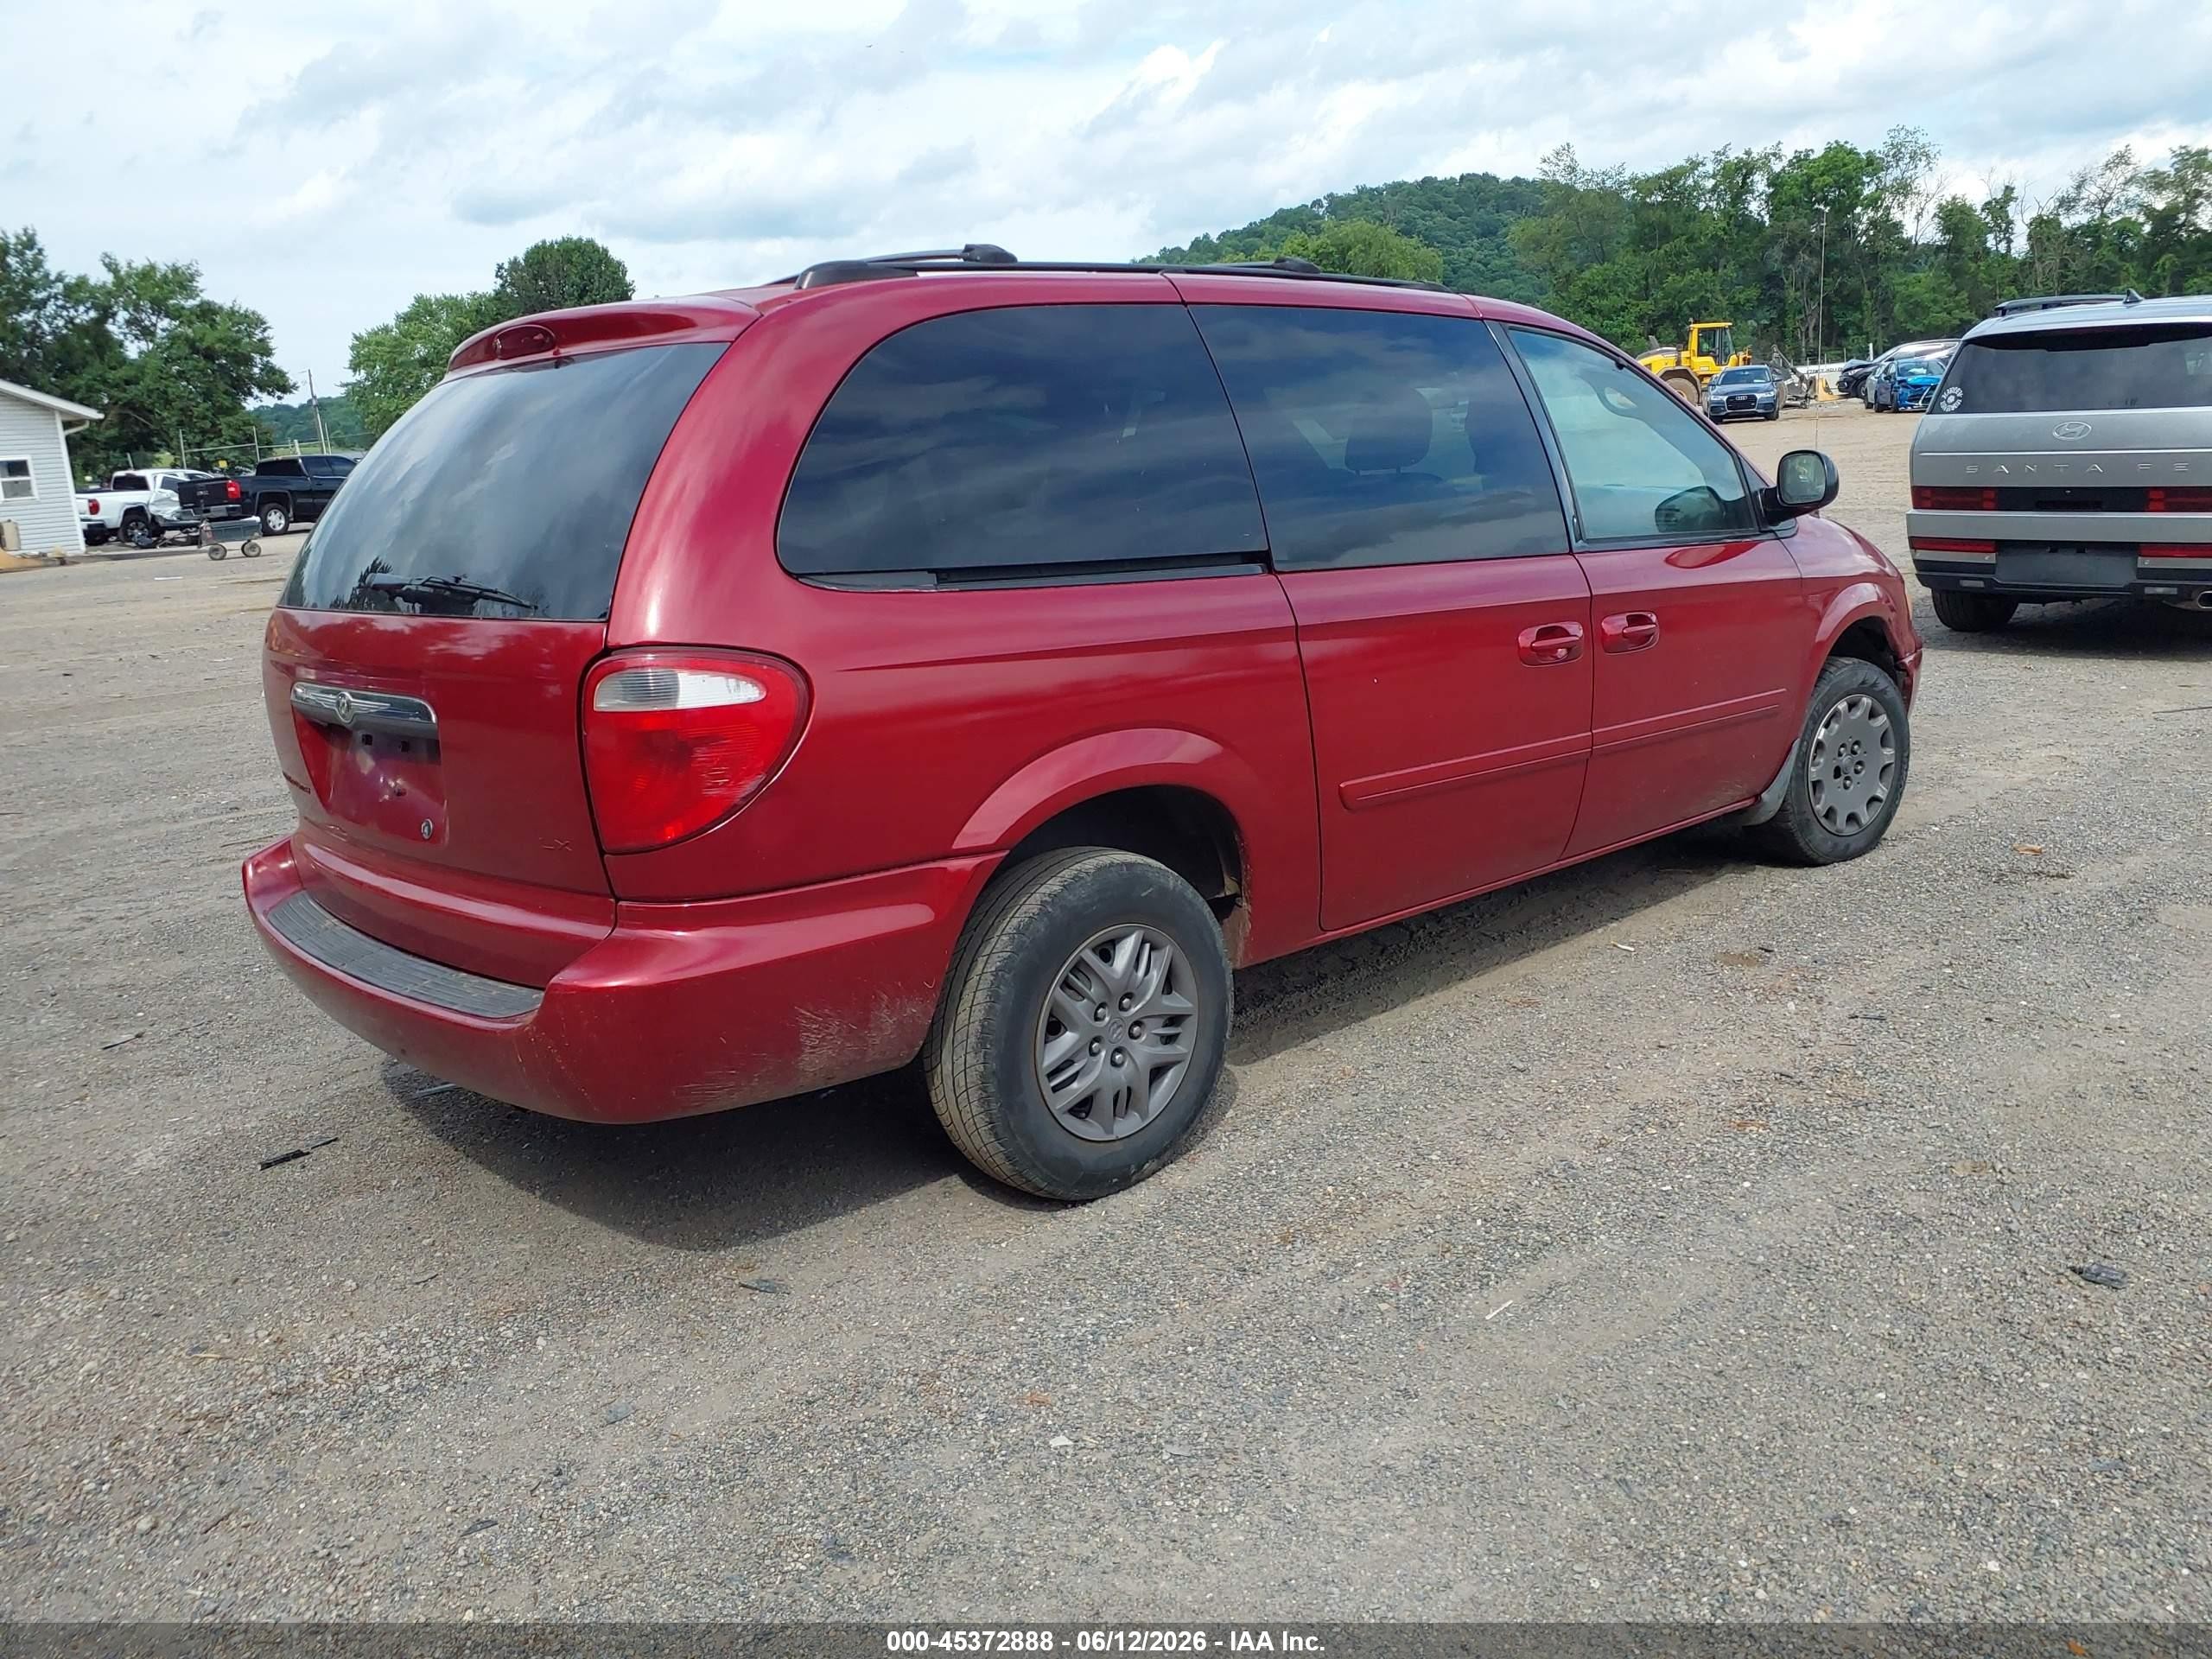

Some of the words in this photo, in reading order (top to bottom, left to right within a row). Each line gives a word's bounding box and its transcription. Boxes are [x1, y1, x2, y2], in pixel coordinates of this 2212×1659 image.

[1965, 463, 2104, 474] SANTA
[2136, 461, 2190, 472] FE
[538, 836, 573, 852] LX
